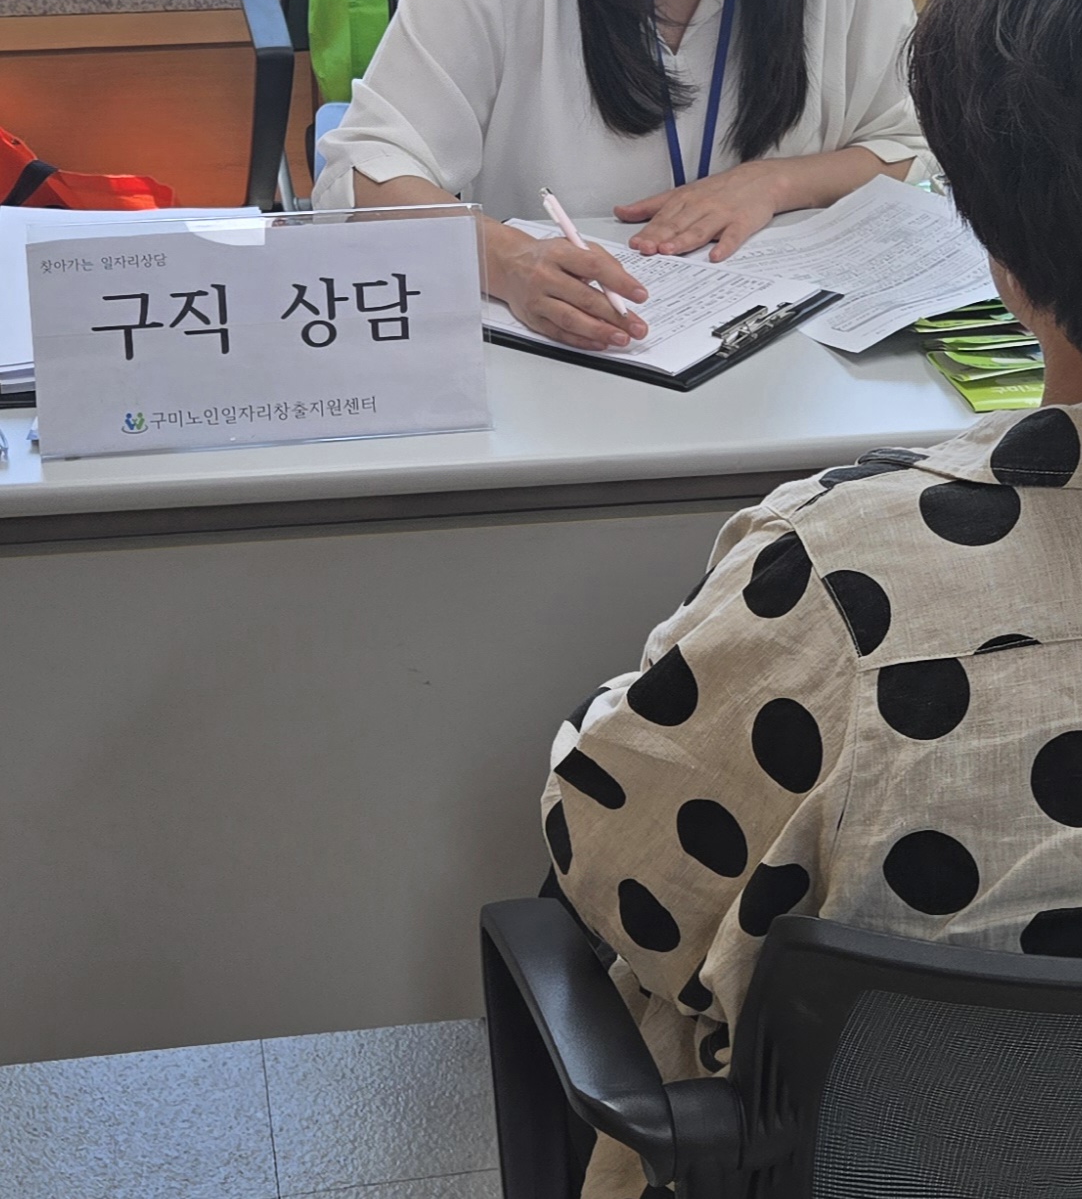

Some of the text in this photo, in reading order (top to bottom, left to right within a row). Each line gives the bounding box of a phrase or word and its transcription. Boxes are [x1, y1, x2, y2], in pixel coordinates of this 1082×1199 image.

[39, 252, 168, 275] 찾아가는 일자리상담
[91, 272, 422, 361] 구직 상담
[148, 394, 378, 430] 구미노인일자리창출지원센터
